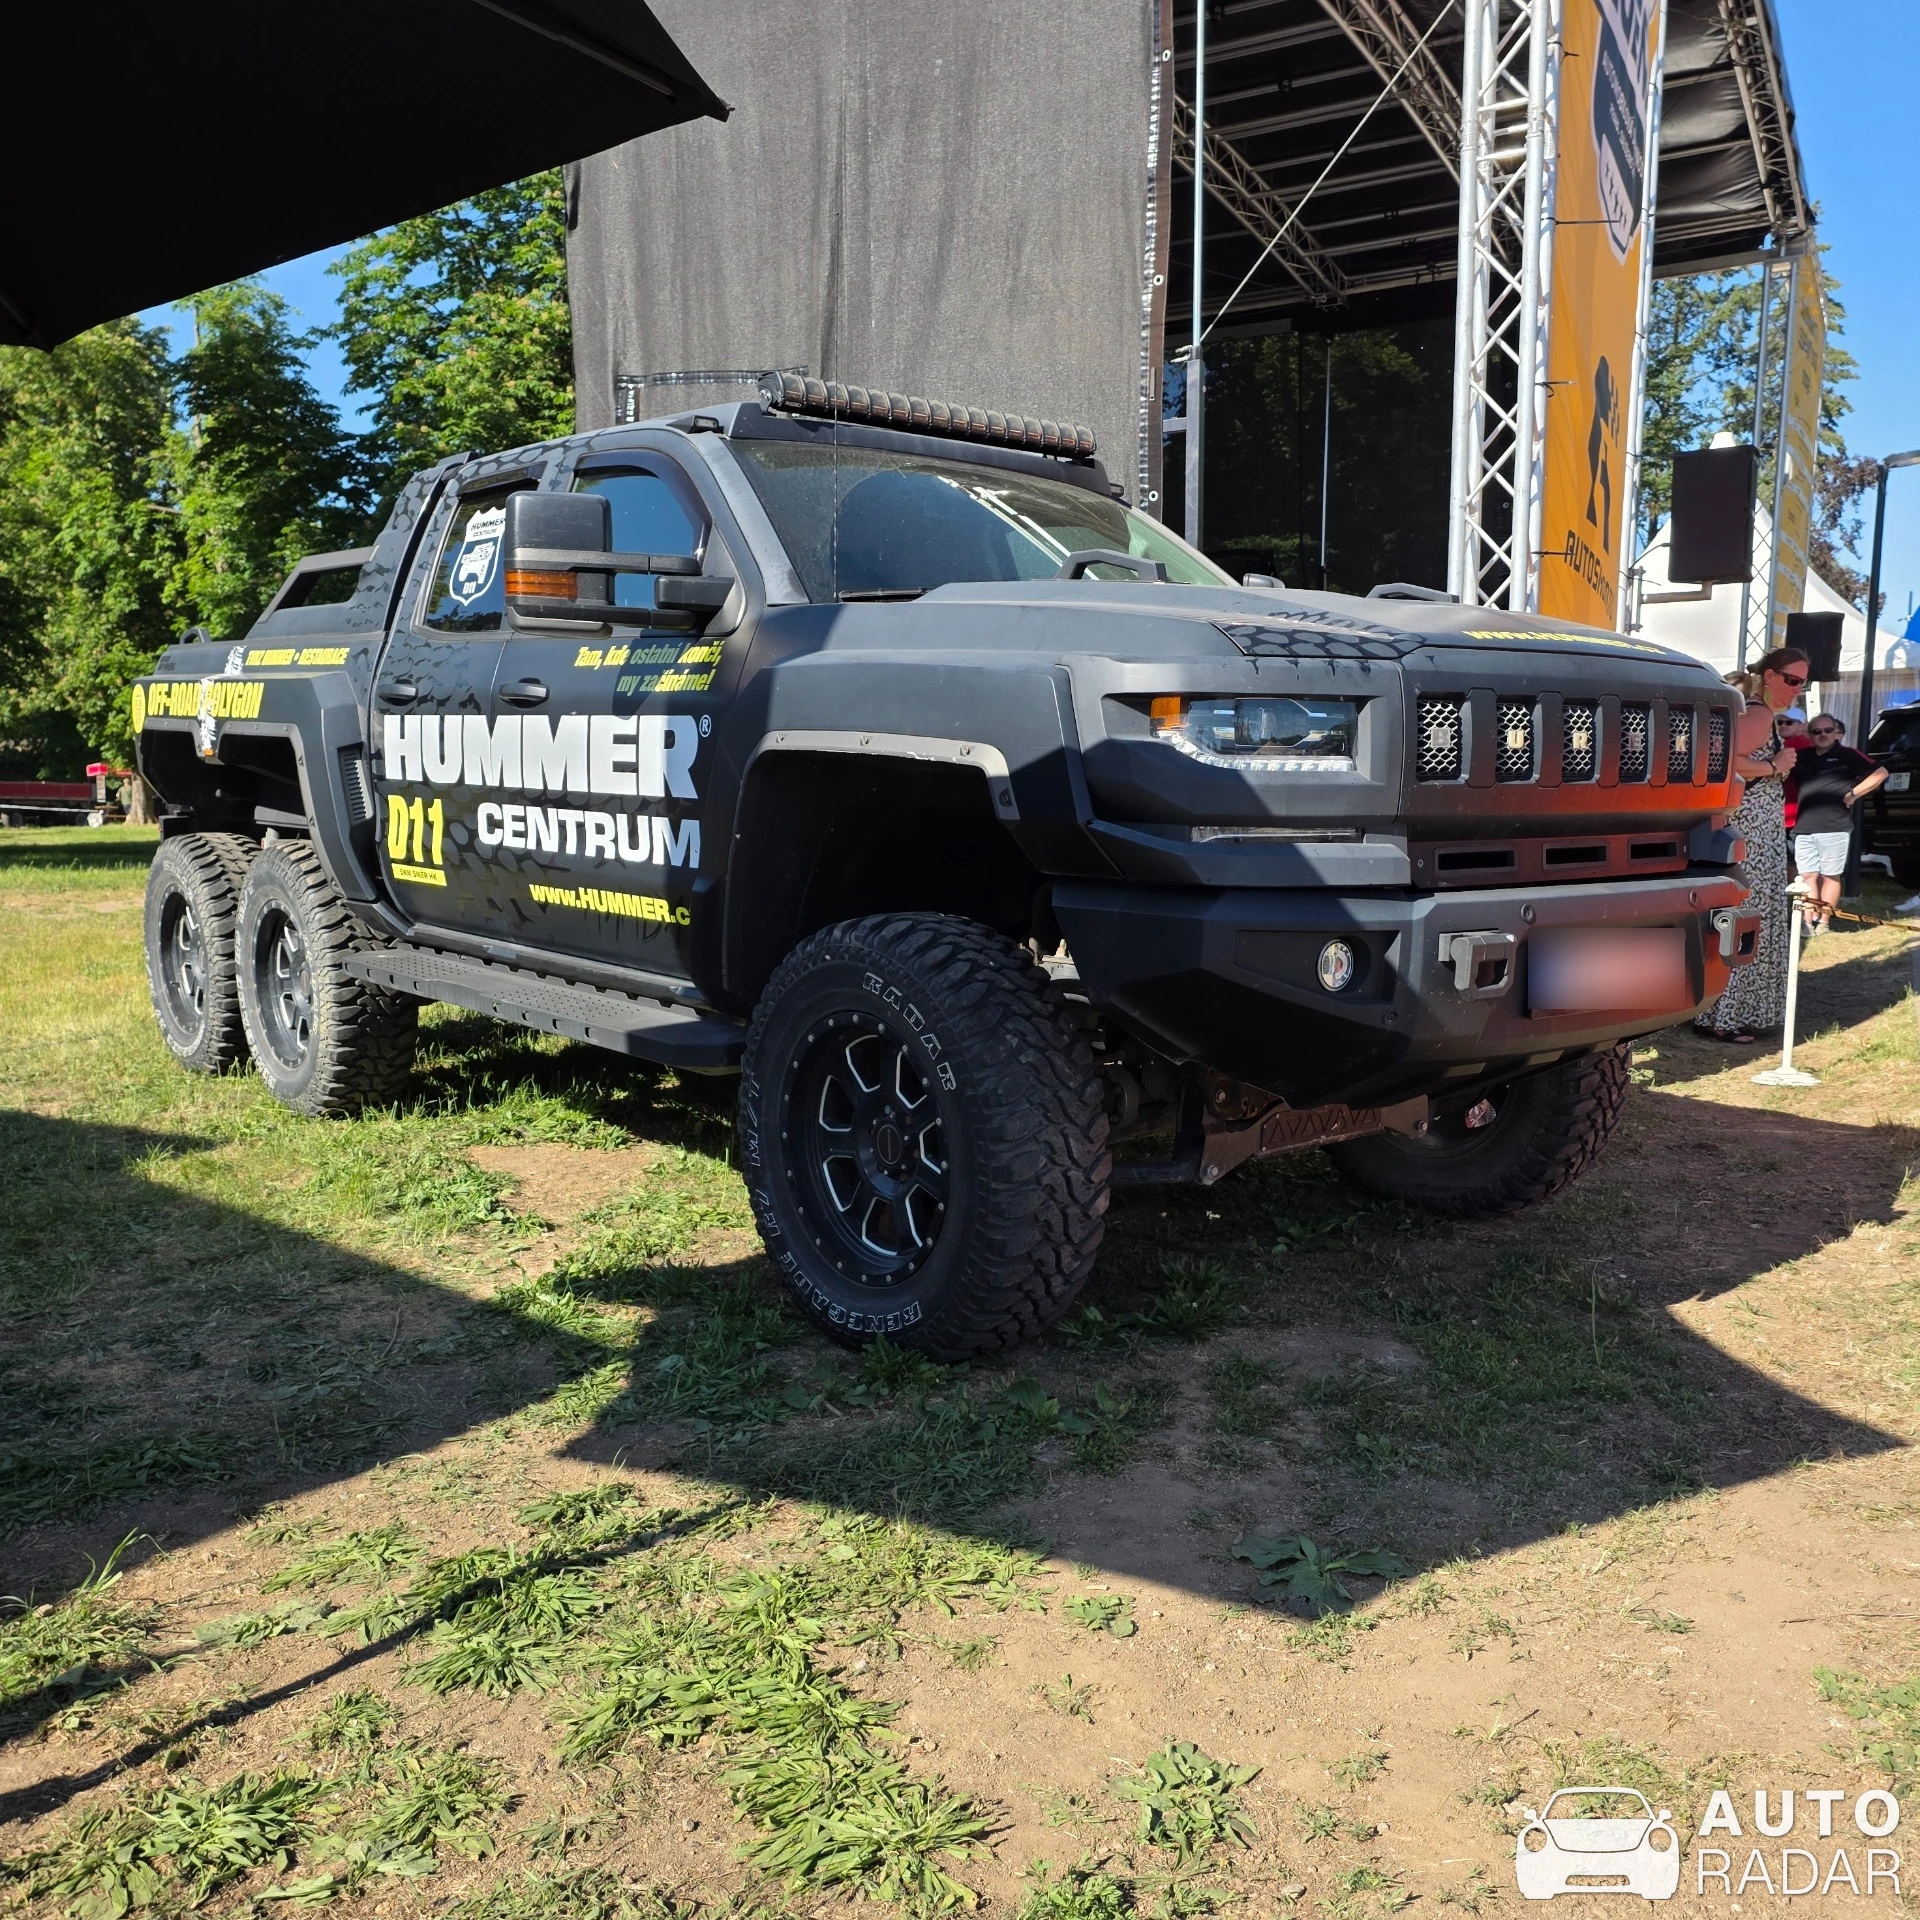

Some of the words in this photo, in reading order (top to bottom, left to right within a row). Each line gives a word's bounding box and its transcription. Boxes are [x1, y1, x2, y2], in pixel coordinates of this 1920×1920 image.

[574, 646, 603, 670] Tam,
[603, 644, 631, 666] kde
[630, 642, 681, 665] ostatní
[677, 640, 725, 667] končí,
[616, 674, 642, 697] my
[639, 668, 716, 692] začínáme!
[147, 682, 202, 717] OFF-ROAD
[387, 794, 443, 866] D11
[477, 802, 701, 870] CENTRUM
[862, 972, 957, 1092] RADAR
[779, 1249, 923, 1333] RENEGADE
